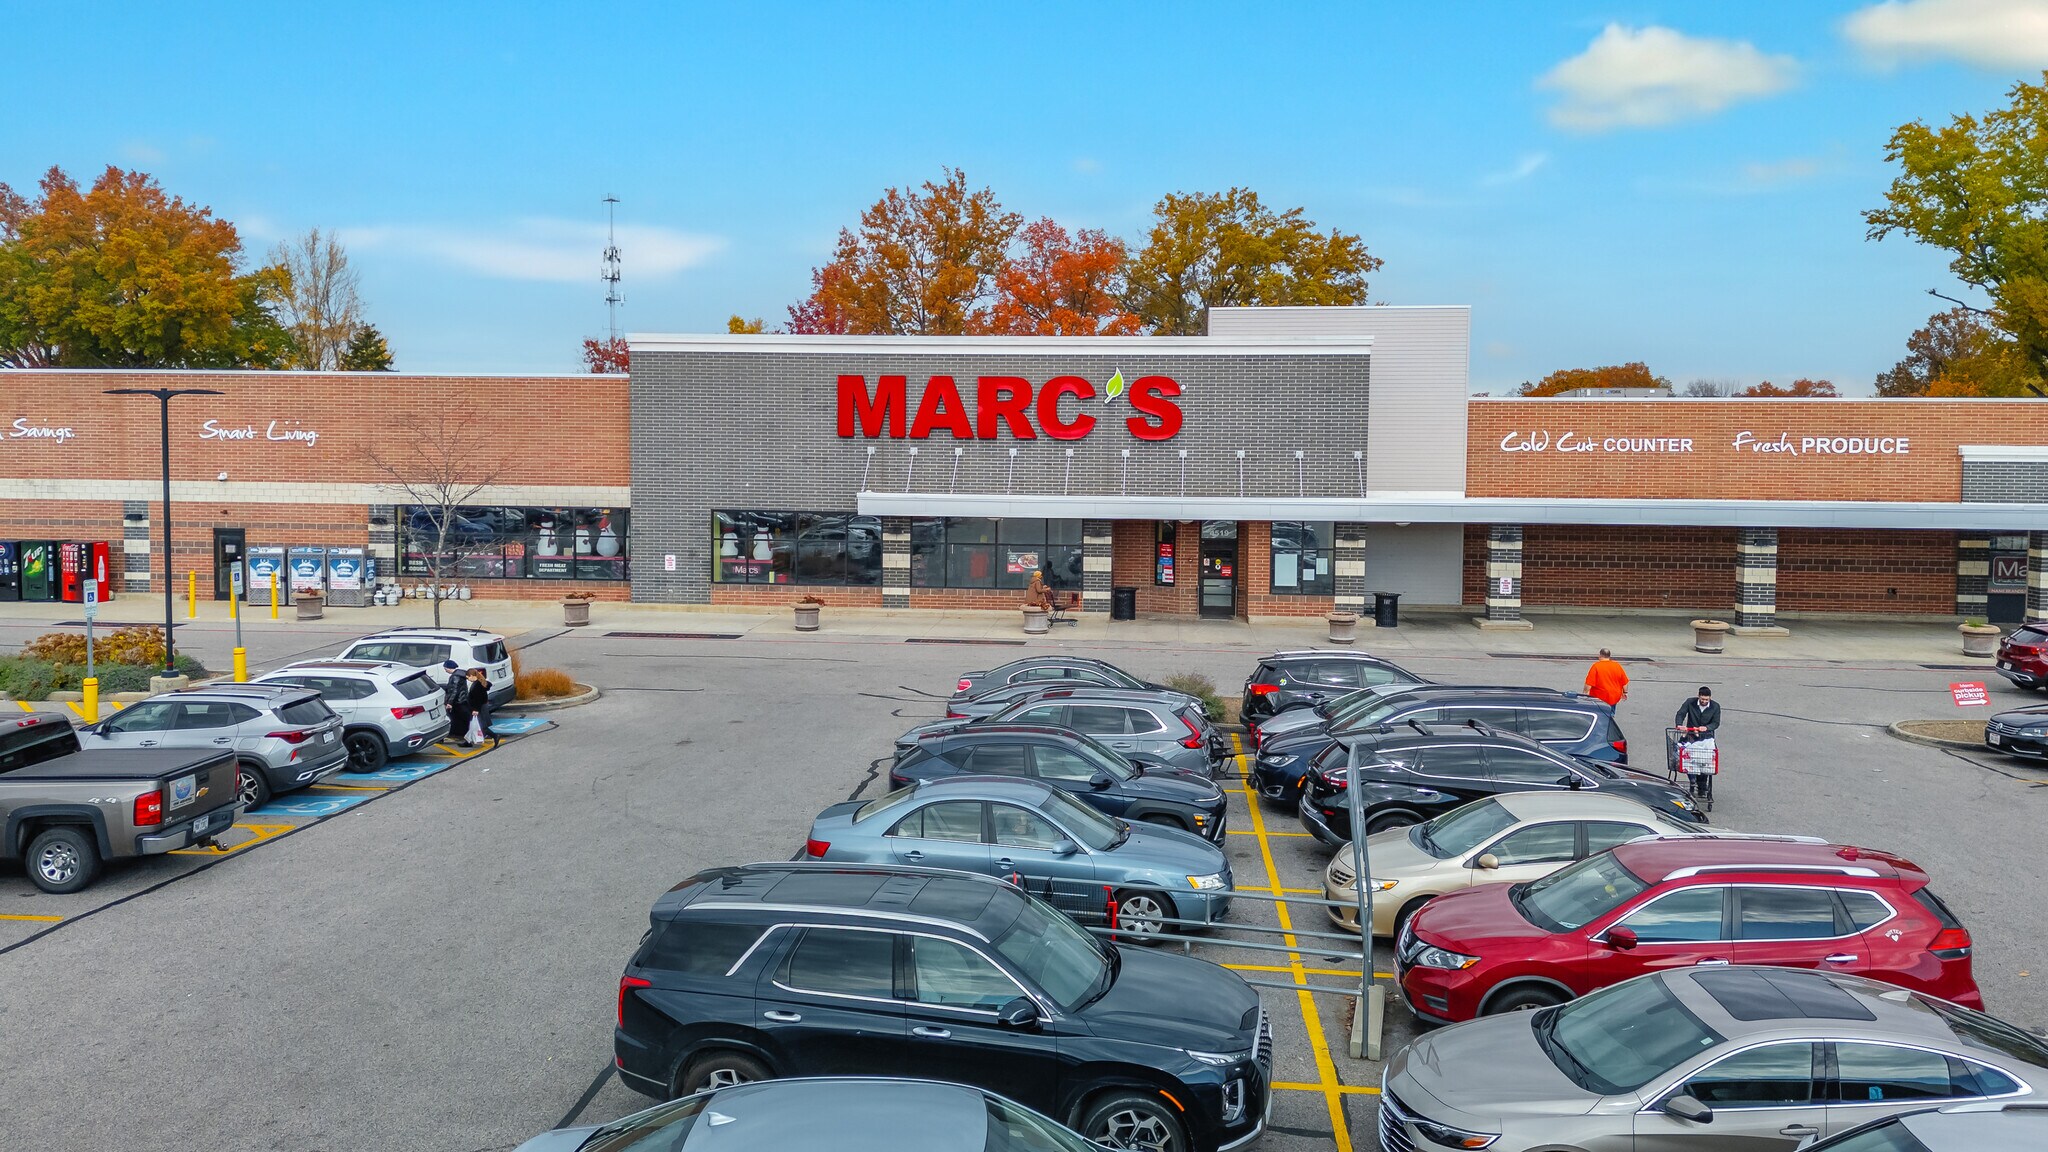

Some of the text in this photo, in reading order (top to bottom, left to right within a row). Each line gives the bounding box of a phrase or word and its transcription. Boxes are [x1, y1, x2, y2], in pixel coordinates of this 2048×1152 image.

[837, 368, 1184, 441] MARC'S
[9, 417, 76, 444] Savings.
[199, 419, 320, 447] Smart Living.
[1500, 430, 1693, 452] Cold Cut COUNTER
[1732, 430, 1910, 456] Fresh PRODUCE
[1955, 692, 1986, 700] pickup
